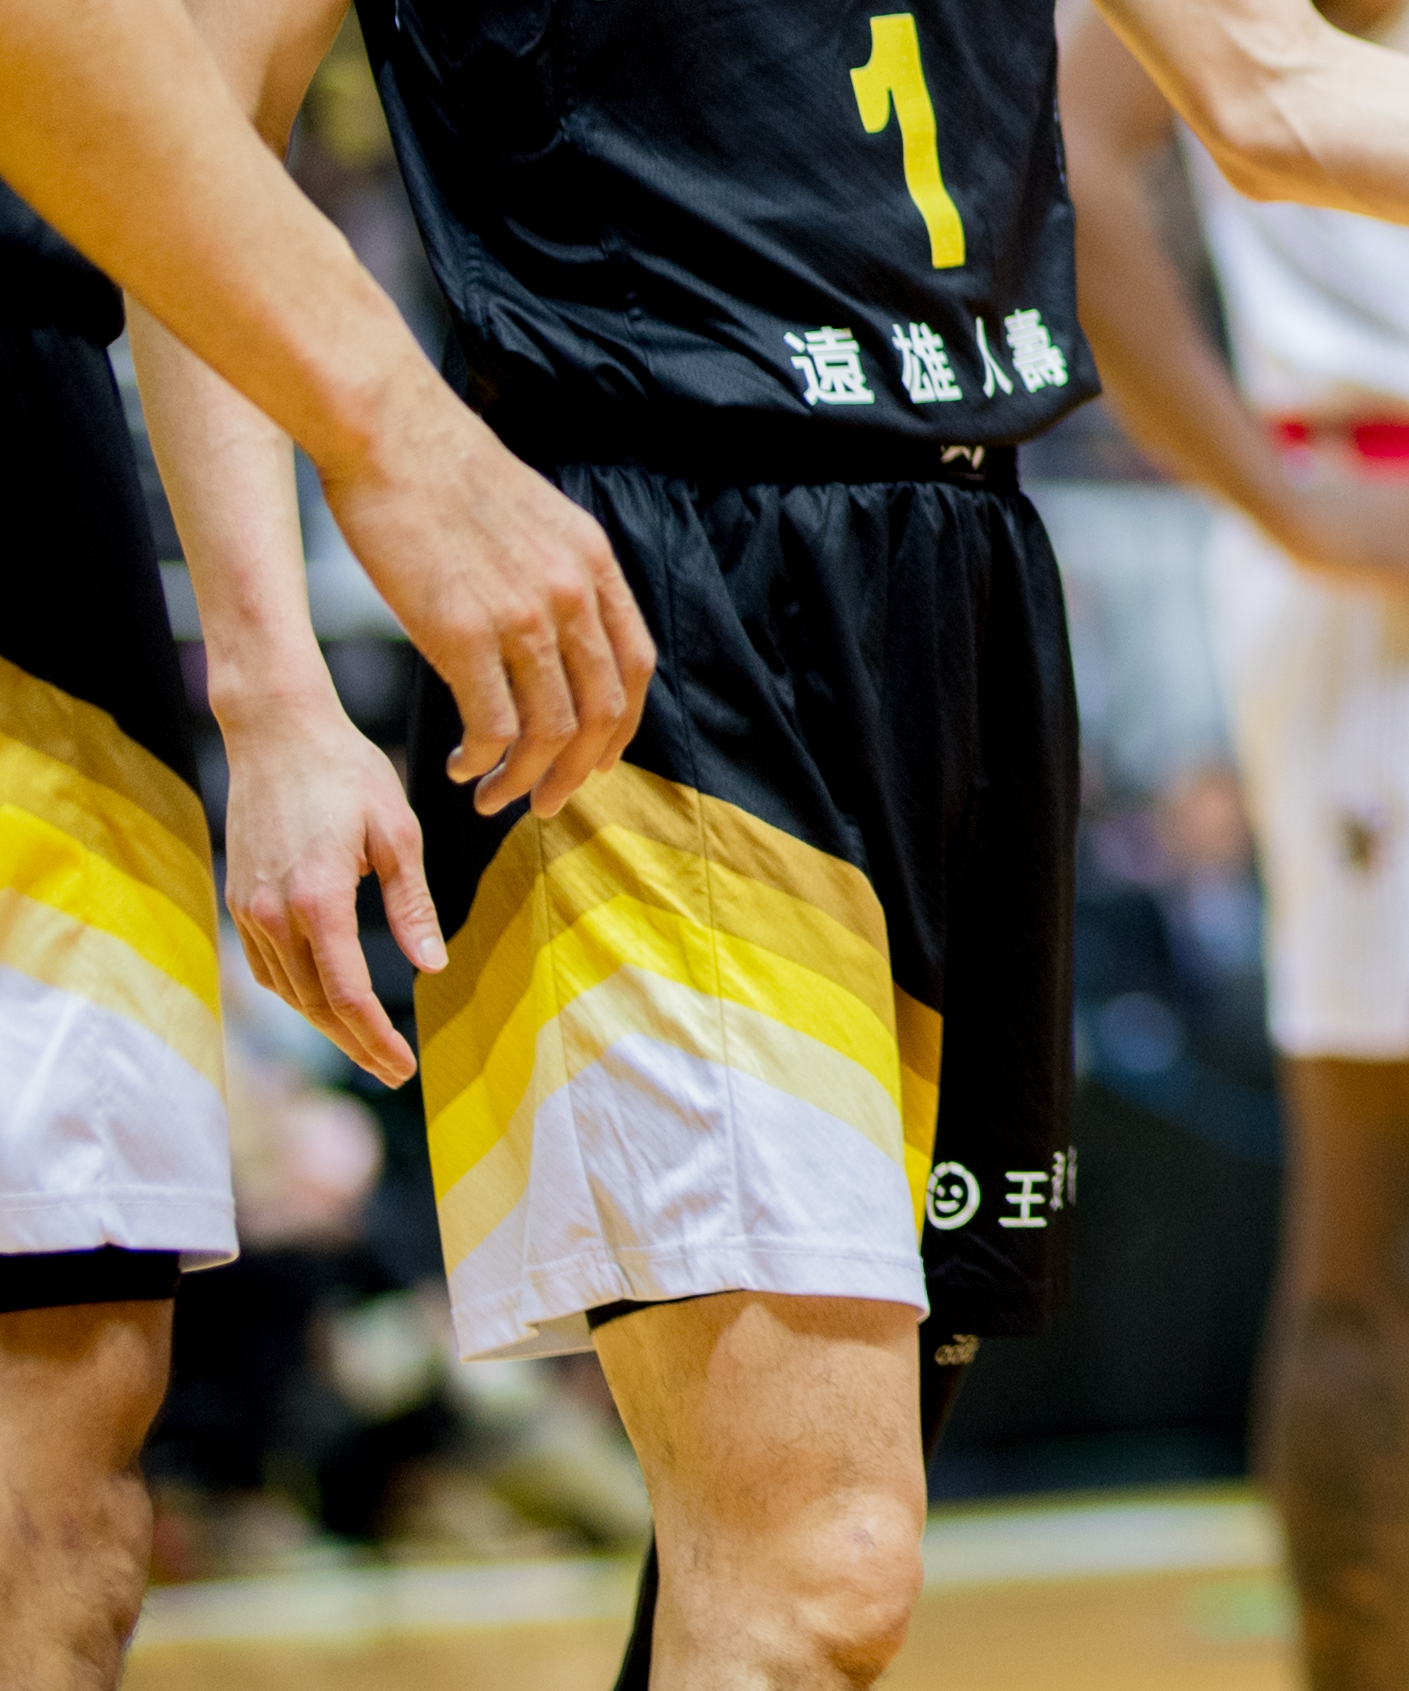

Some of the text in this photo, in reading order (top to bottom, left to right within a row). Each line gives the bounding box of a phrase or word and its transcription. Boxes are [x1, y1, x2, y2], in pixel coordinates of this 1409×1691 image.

[849, 12, 966, 270] 1
[783, 308, 1068, 406] 遠雄人壽
